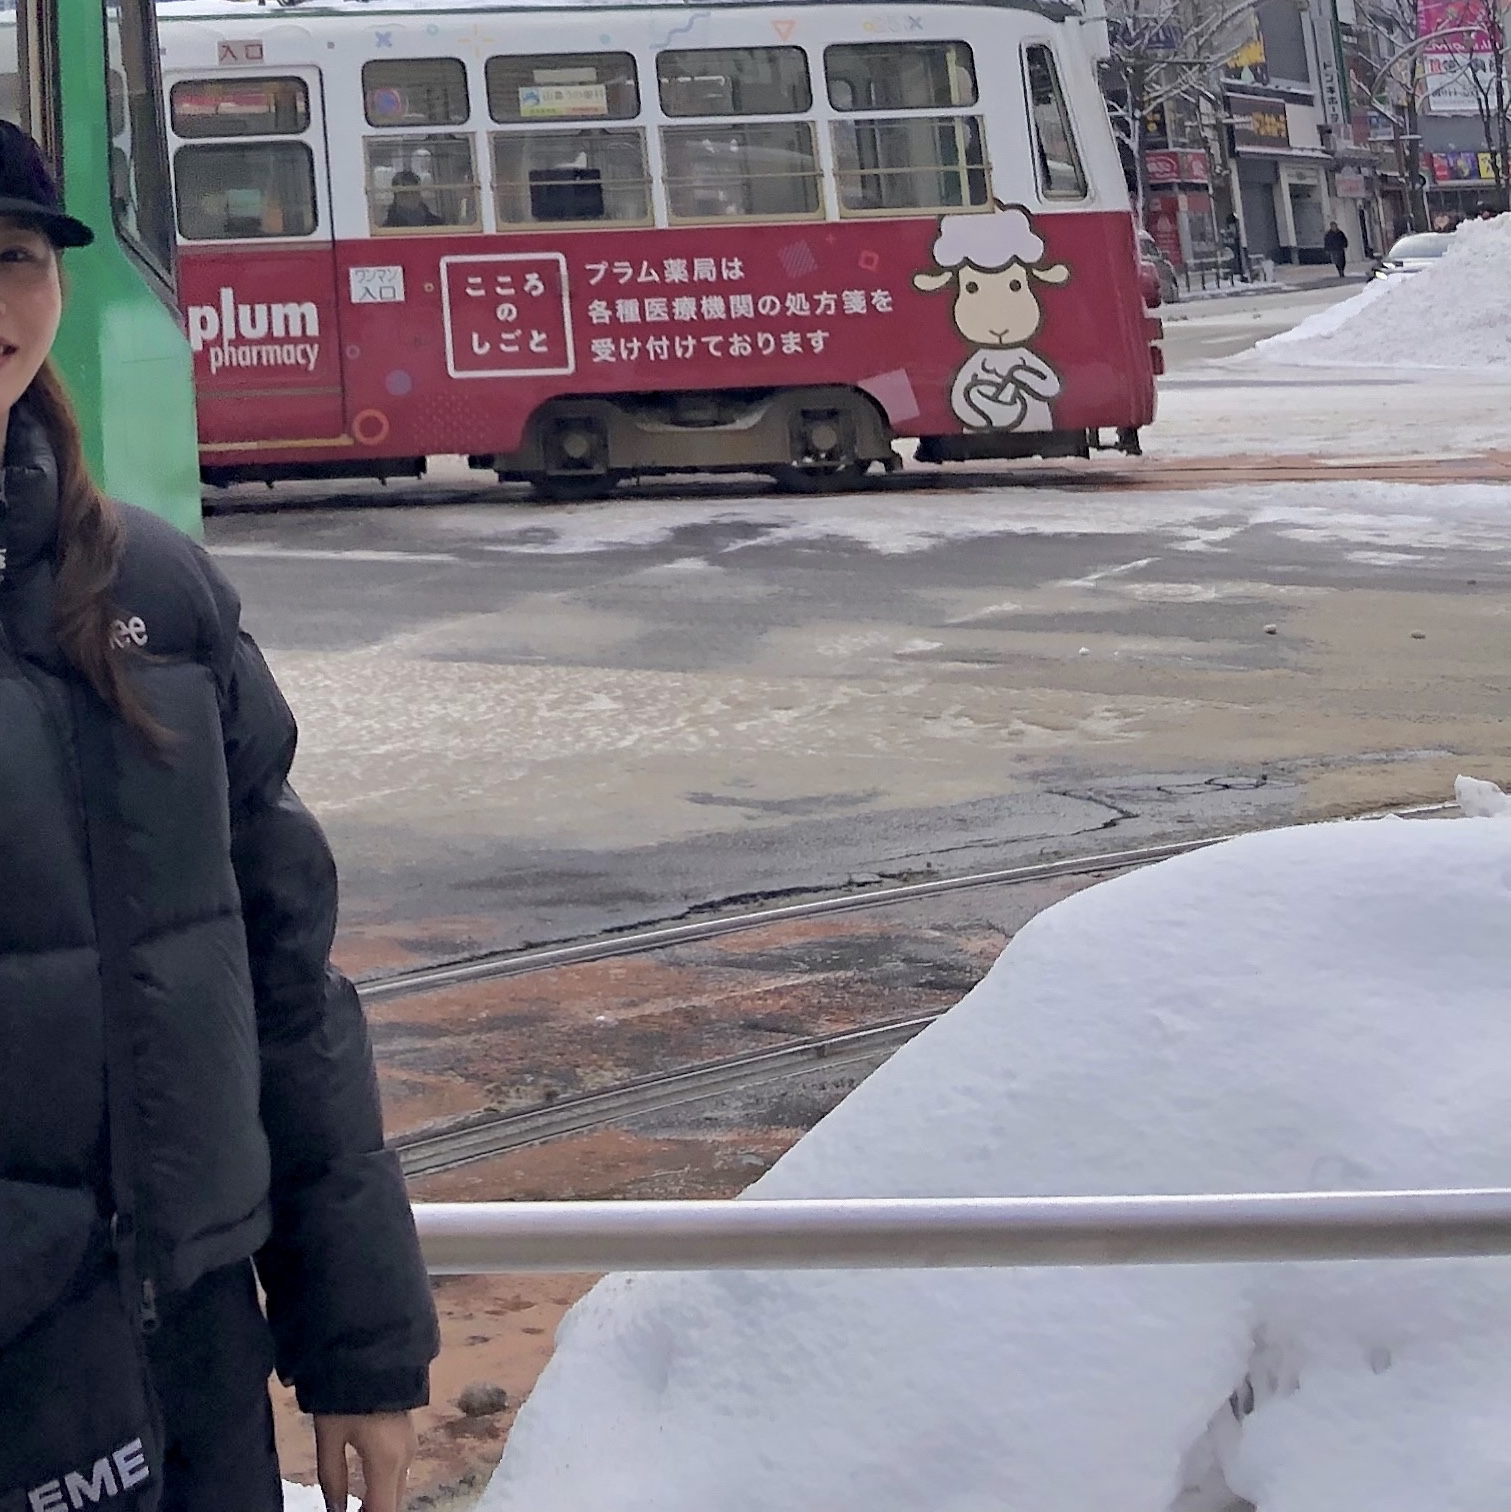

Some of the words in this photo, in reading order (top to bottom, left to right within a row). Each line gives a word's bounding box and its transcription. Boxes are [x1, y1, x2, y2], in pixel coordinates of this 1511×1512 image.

[220, 44, 263, 61] 入口
[355, 269, 398, 284] ワンマン
[465, 273, 545, 297] こころ
[585, 257, 745, 285] プラム薬局は
[359, 286, 397, 301] 入口
[189, 288, 319, 351] plum
[496, 303, 518, 323] の
[588, 292, 894, 326] 各種医療機関の処方箋を
[472, 330, 549, 355] しごと
[591, 328, 830, 362] 受け付けております
[209, 339, 320, 375] pharmacy
[109, 615, 149, 650] ee
[27, 1438, 150, 1512] EME
